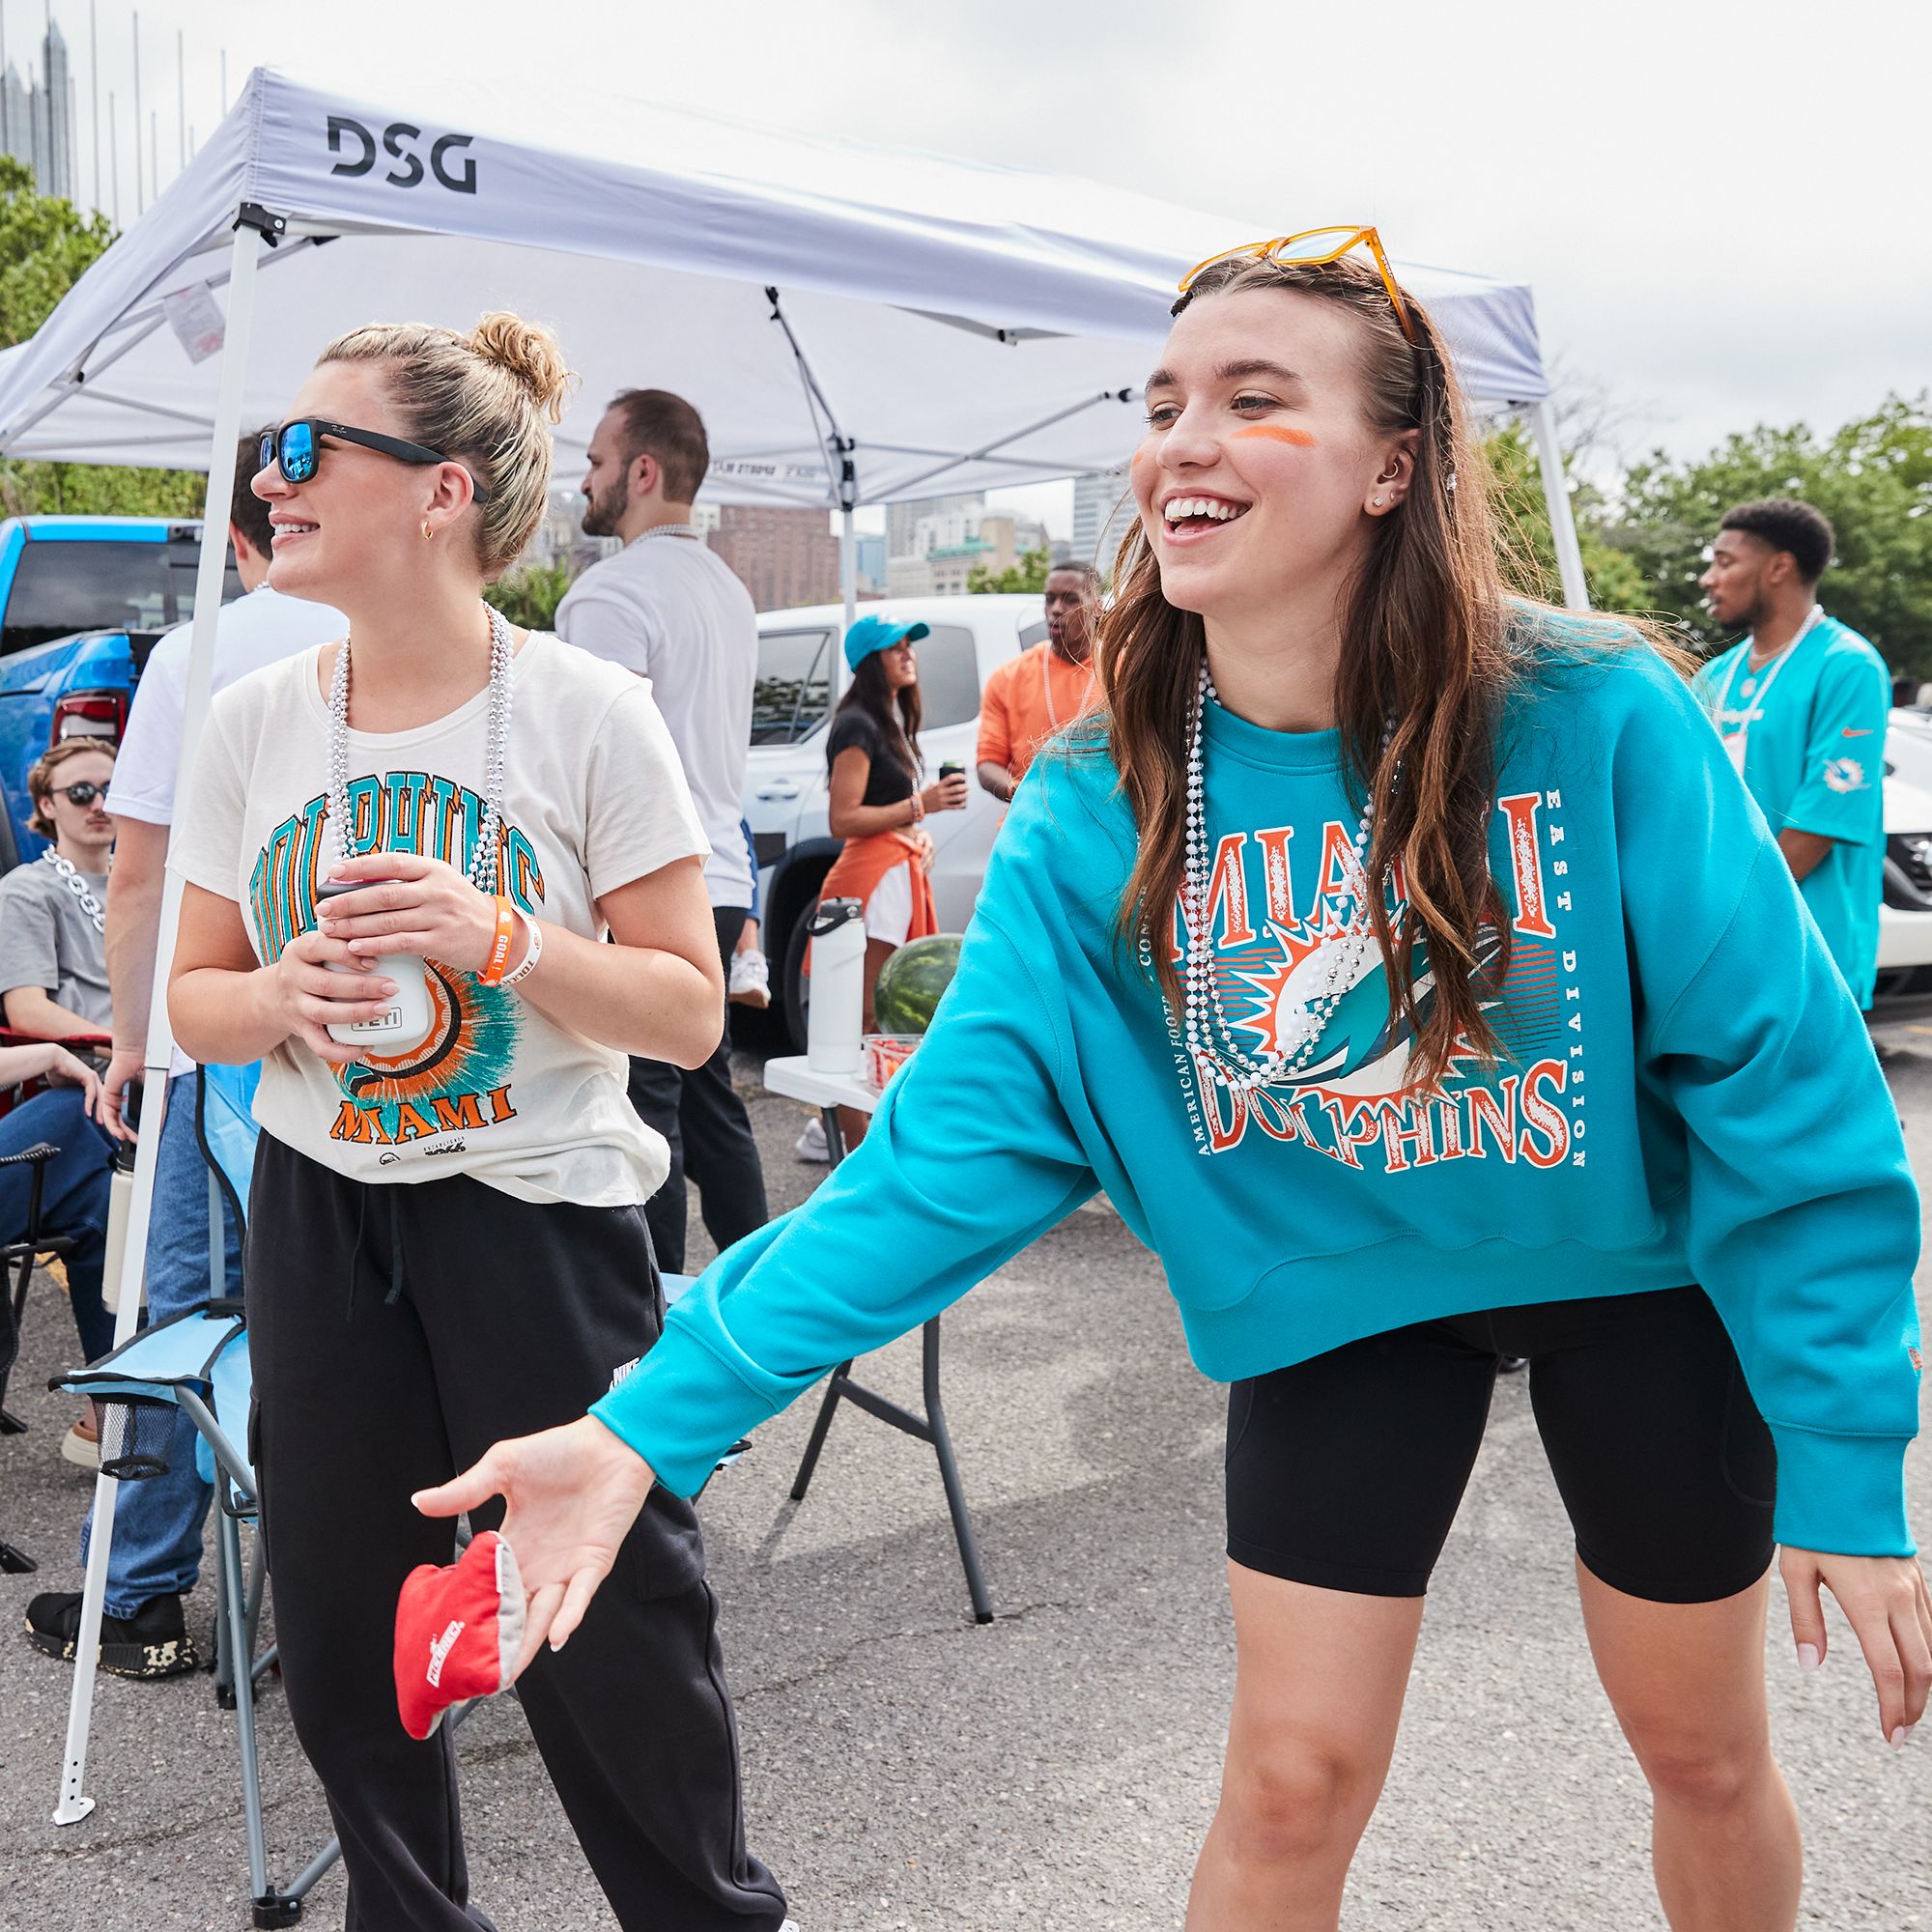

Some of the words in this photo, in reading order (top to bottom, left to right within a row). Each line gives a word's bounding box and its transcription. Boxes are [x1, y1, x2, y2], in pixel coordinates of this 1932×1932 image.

[327, 116, 476, 194] DSG
[1546, 789, 1573, 911] EAST
[1562, 950, 1586, 1167] DIVISION
[329, 1084, 518, 1145] MIAMI
[1175, 1050, 1210, 1156] AMERICAN
[1189, 1042, 1573, 1174] DOLPHINS
